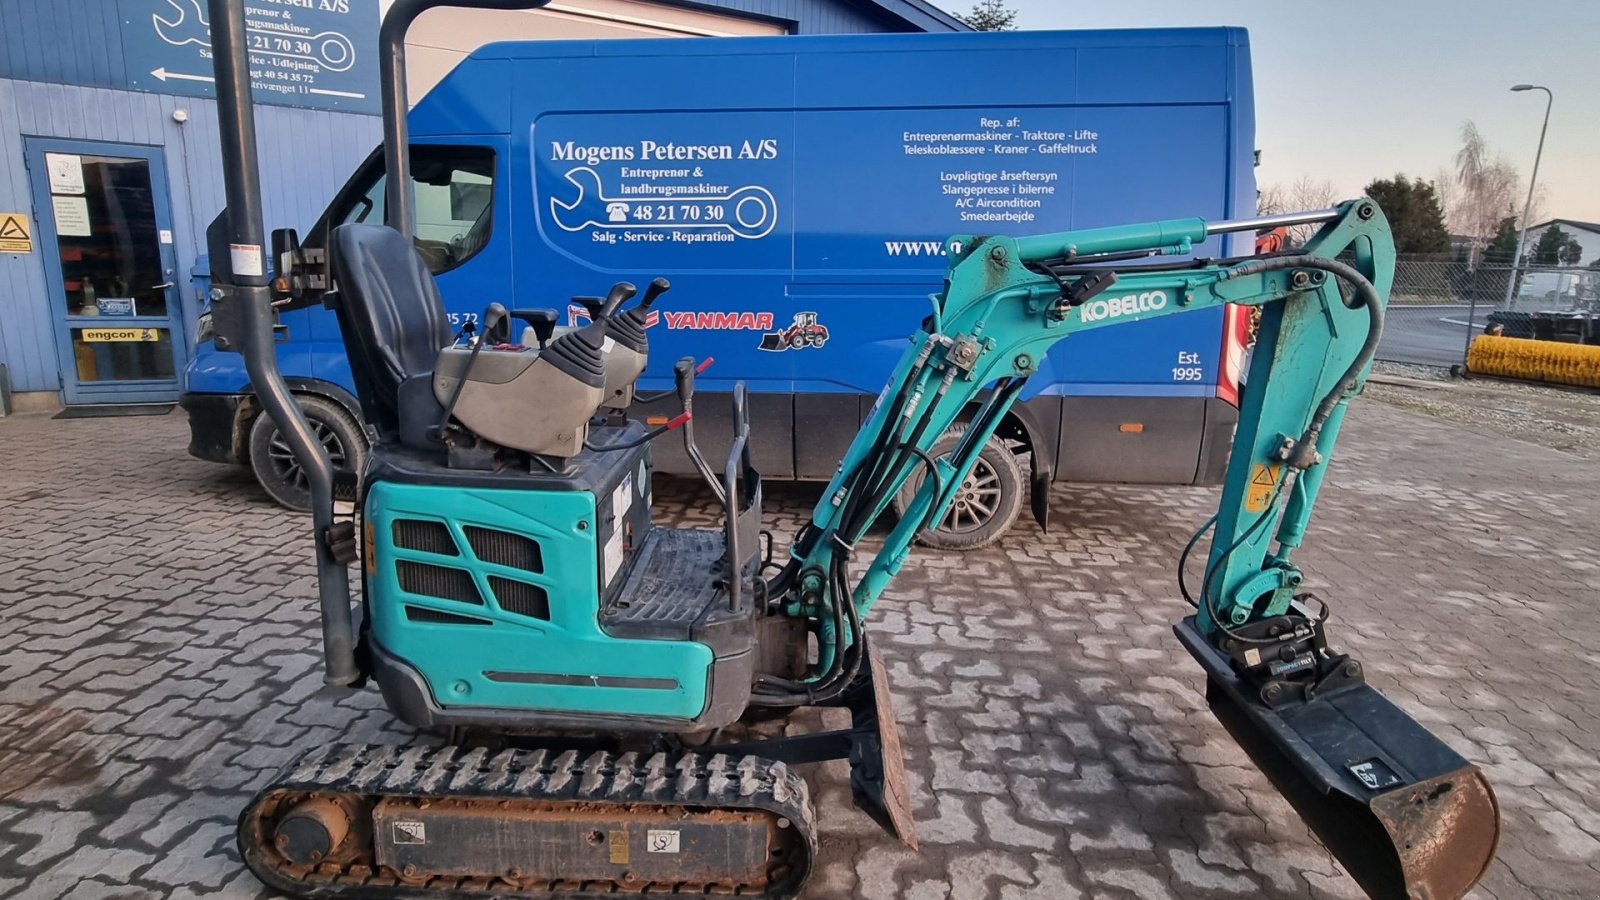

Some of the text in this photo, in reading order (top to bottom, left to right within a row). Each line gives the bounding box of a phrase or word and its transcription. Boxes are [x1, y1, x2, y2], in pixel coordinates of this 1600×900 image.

[282, 10, 292, 20] &
[253, 36, 271, 49] 21
[274, 38, 292, 52] 70
[294, 41, 312, 54] 30
[272, 57, 320, 73] Udlejning
[264, 70, 276, 79] 40
[277, 72, 289, 81] 54
[290, 73, 302, 82] 35
[302, 74, 315, 83] 72
[980, 117, 1021, 129] Rep. af:
[903, 131, 1012, 143] Entreprenørmaskiner
[1022, 131, 1066, 141] Traktore
[1074, 130, 1098, 141] Lifte
[551, 139, 778, 165] Mogens Petersen A/S
[904, 145, 986, 155] Teleskoblæssere
[994, 145, 1029, 154] Kraner
[1038, 144, 1097, 154] Gaffeltruck
[621, 166, 704, 179] Entreprenør &
[940, 169, 1058, 183] Lovpligtige årseftersyn
[621, 183, 730, 196] landbrugsmaskiner
[942, 184, 1010, 197] Slangepresse
[1018, 184, 1055, 195] bilerne
[955, 198, 1041, 208] A/C Aircondition
[633, 205, 724, 220] 48 21 70 30
[960, 211, 1035, 223] Smedearbejde
[592, 231, 735, 244] Salg Service Reparation
[1080, 290, 1167, 323] KOBELCO
[462, 312, 479, 325] 72
[663, 311, 774, 331] YANMAR
[87, 332, 135, 340] engcon
[1178, 351, 1201, 365] Est.
[1171, 368, 1202, 381] 1995
